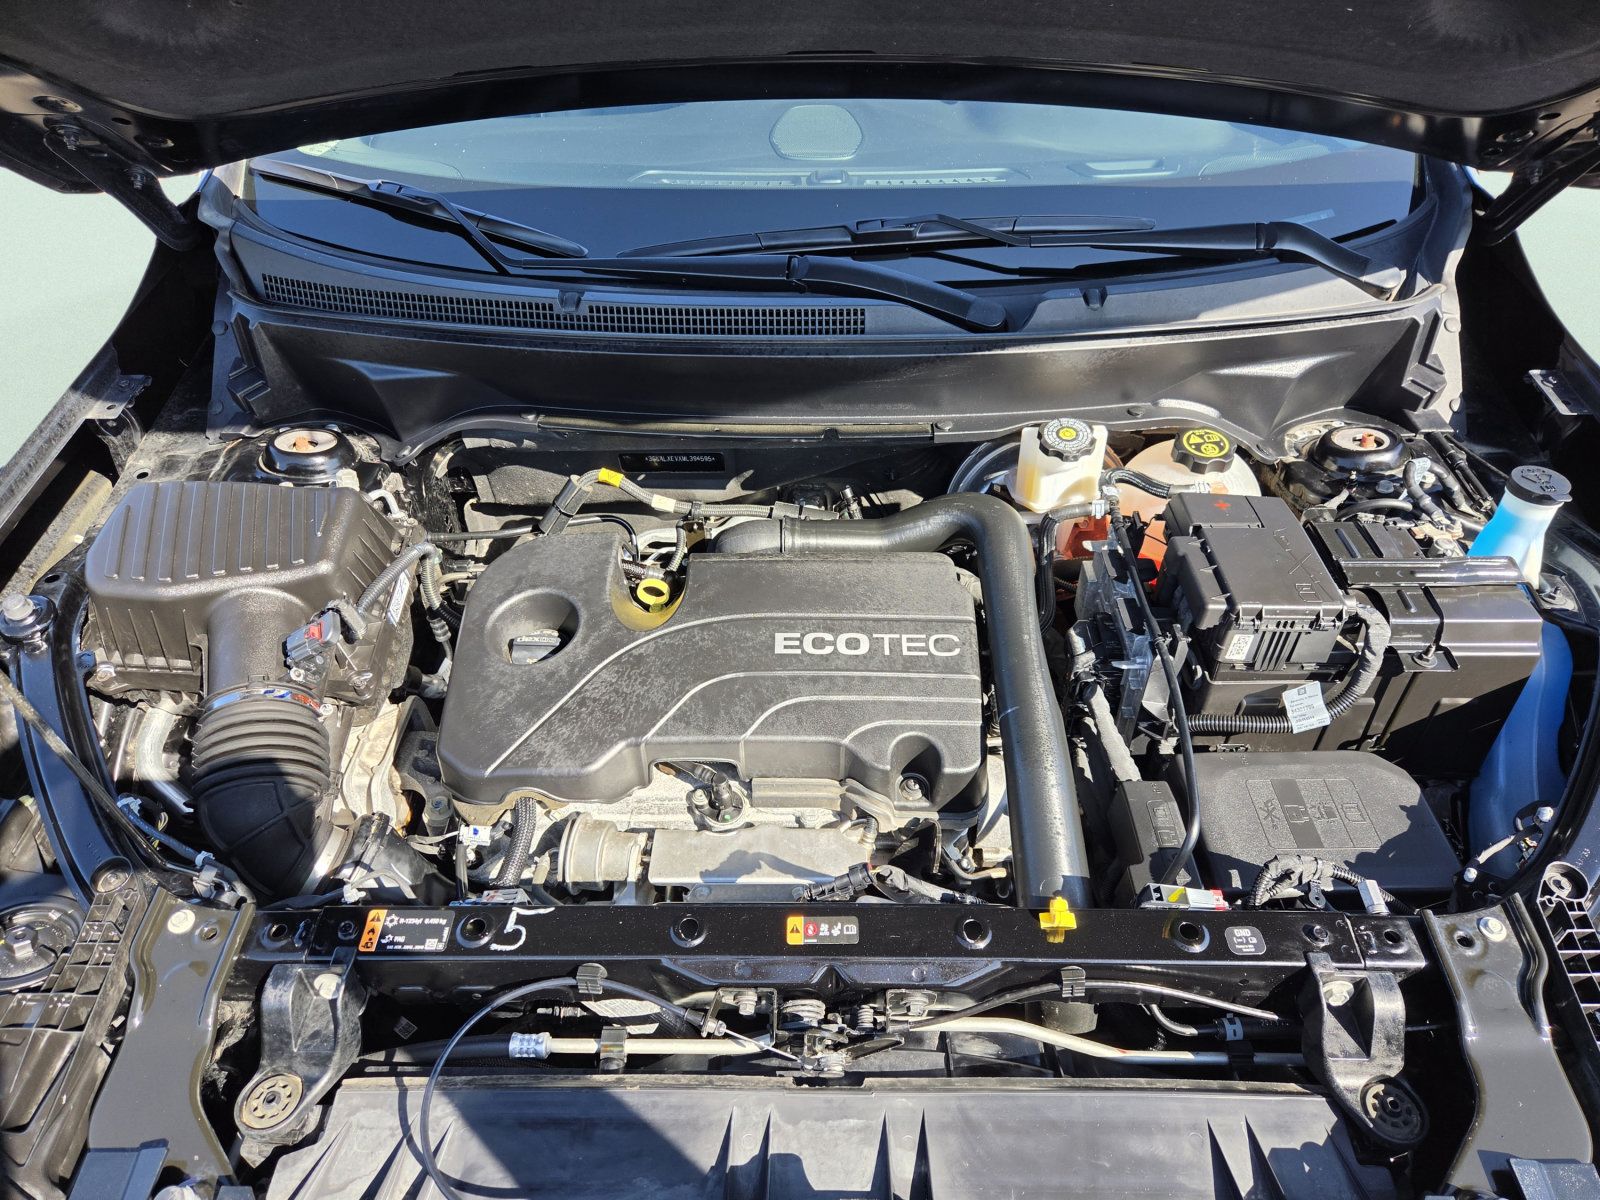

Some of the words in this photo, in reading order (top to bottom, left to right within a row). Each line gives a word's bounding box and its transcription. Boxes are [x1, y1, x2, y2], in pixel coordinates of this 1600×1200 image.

[774, 632, 961, 656] ECOTEC
[489, 906, 555, 951] 5
[1234, 929, 1251, 937] GND
